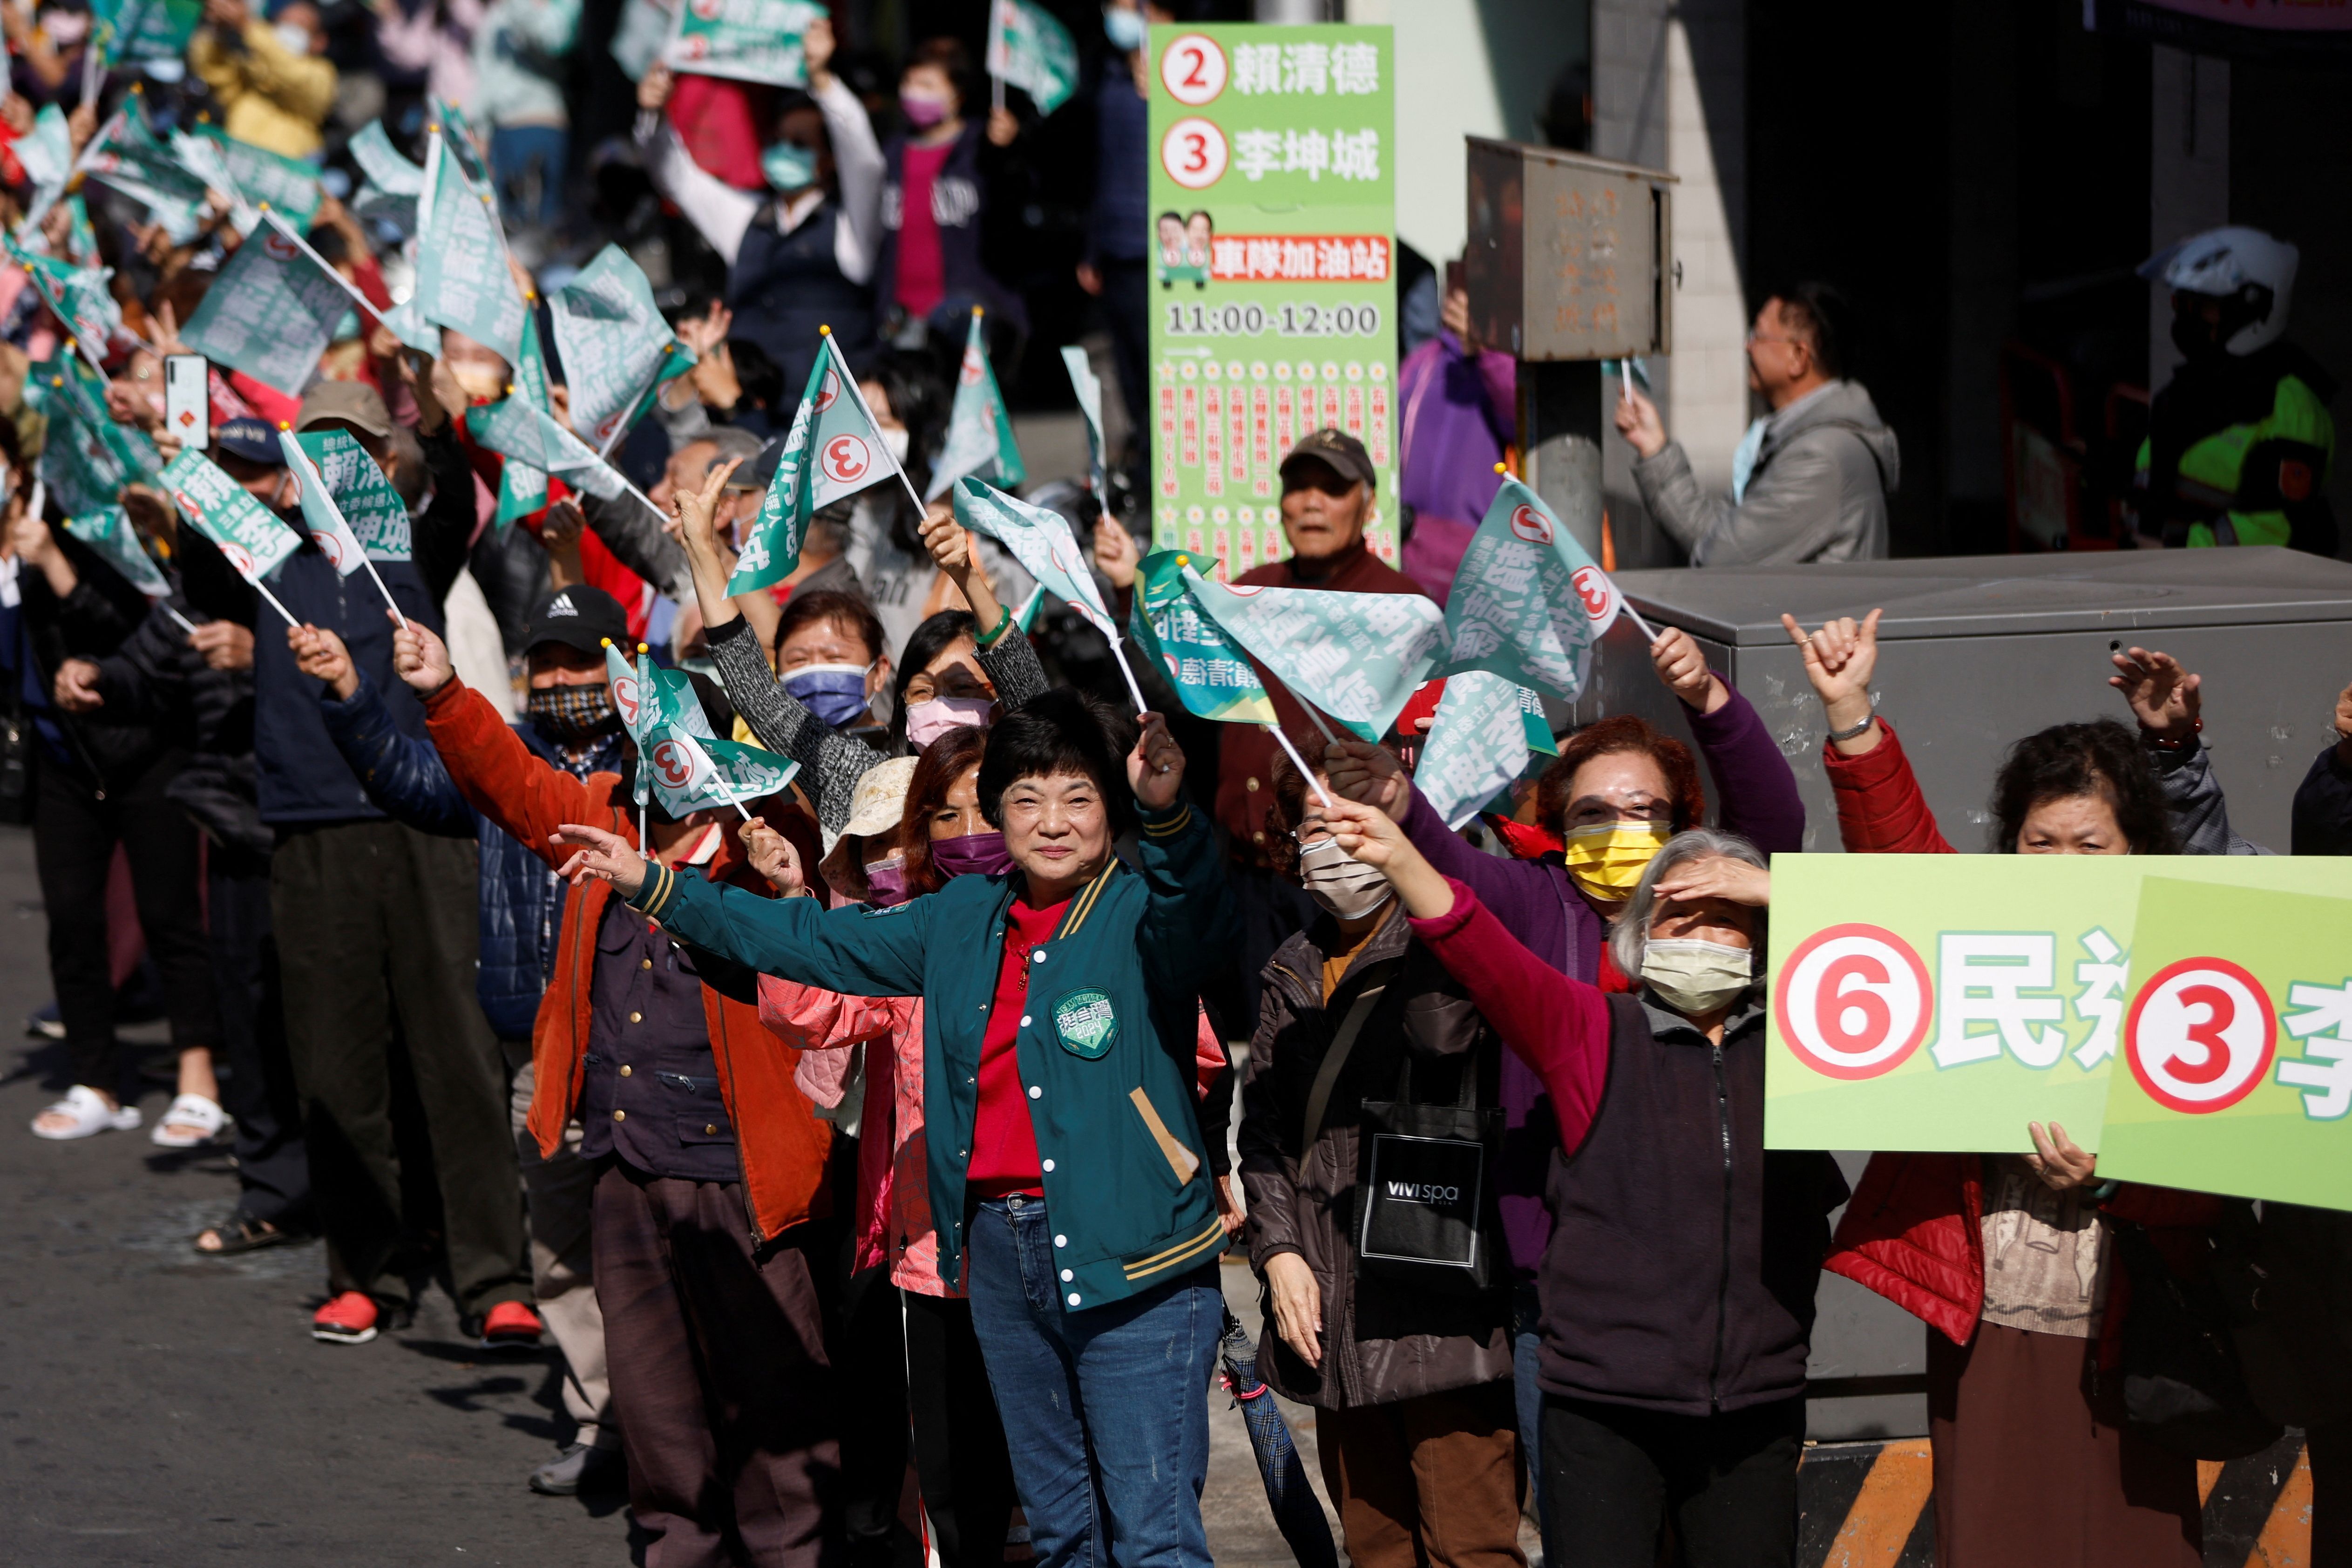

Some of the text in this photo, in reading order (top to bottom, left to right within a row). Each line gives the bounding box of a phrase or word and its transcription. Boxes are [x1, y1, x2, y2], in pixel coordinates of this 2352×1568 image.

[1233, 41, 1379, 95] 賴清德
[1234, 128, 1380, 182] 李坤城
[1212, 238, 1387, 279] 車隊加油站
[1168, 303, 1379, 334] 11:00-12:00
[1057, 993, 1105, 1015] TEAM TAIWAN
[1057, 998, 1114, 1037] 挺台灣
[1815, 953, 1891, 1054] 6
[1075, 1020, 1103, 1039] 2024
[2162, 984, 2236, 1086] 3
[1423, 1184, 1459, 1204] spa
